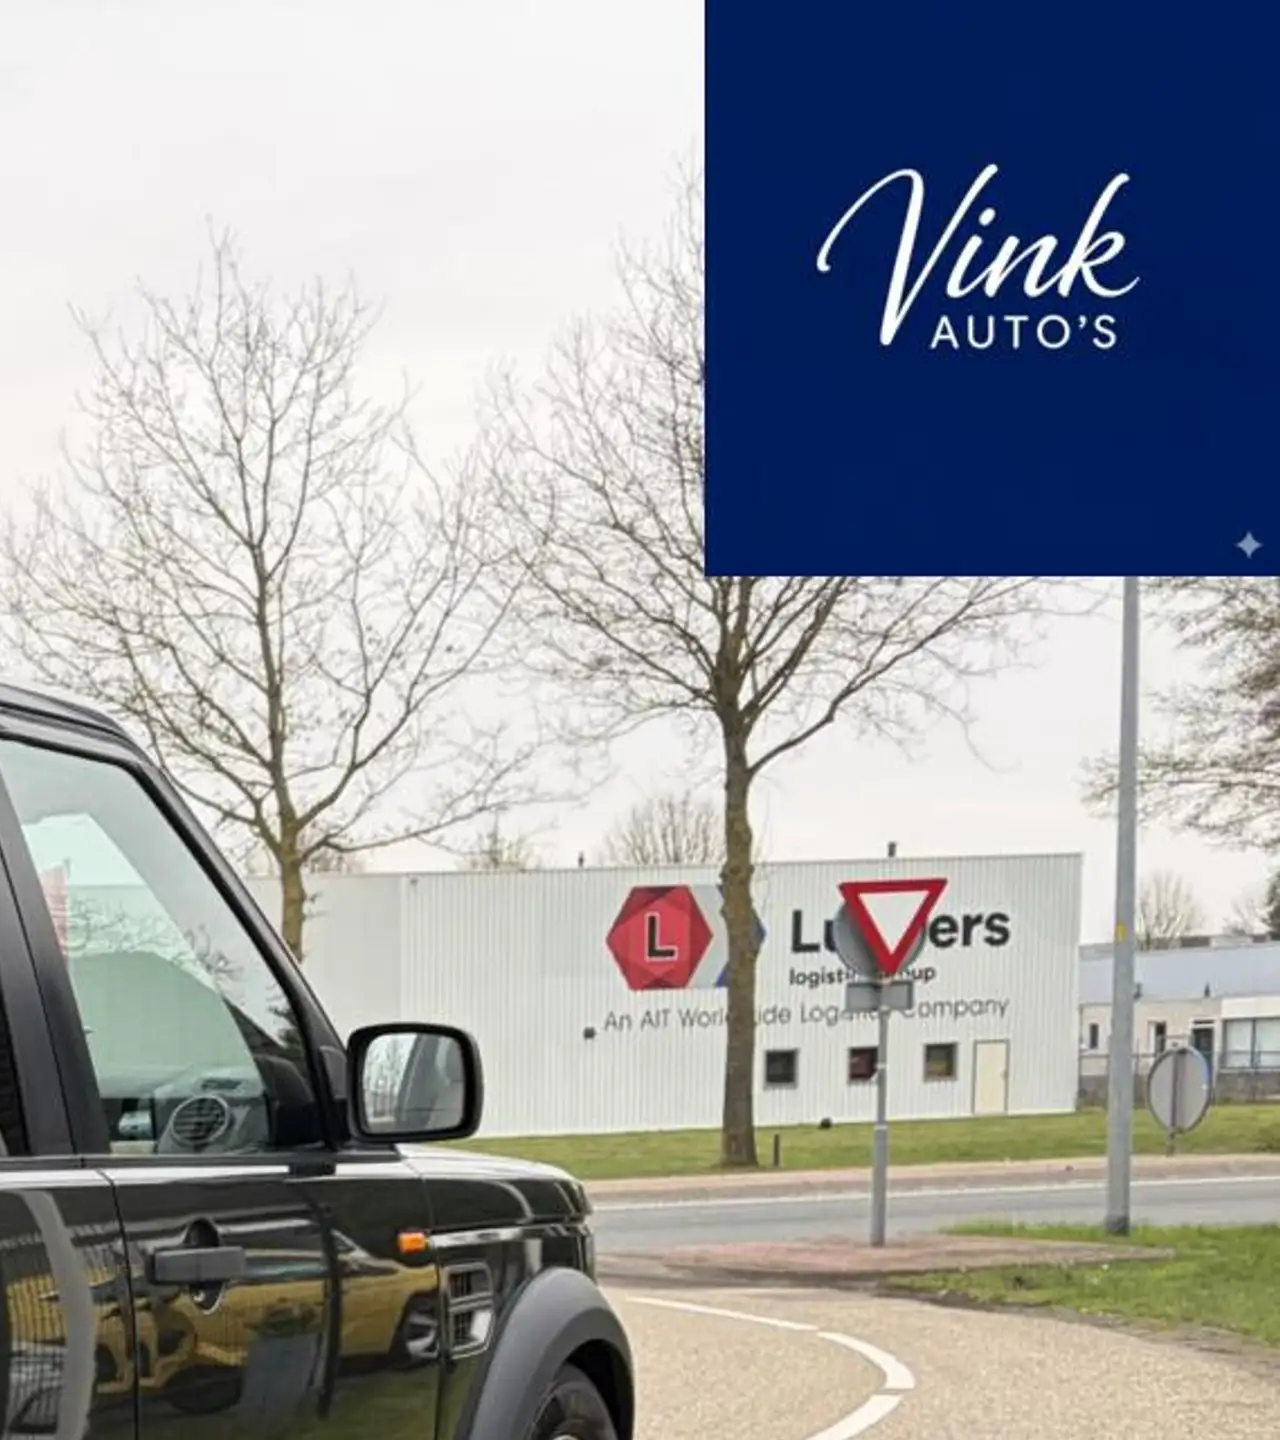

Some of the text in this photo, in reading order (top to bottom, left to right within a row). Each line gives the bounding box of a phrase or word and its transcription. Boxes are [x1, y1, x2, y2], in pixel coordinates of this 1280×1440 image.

[645, 913, 678, 960] L
[792, 909, 1011, 954] Lers
[604, 1010, 632, 1032] An
[641, 1008, 671, 1031] AIT
[677, 1003, 792, 1028] Worlide
